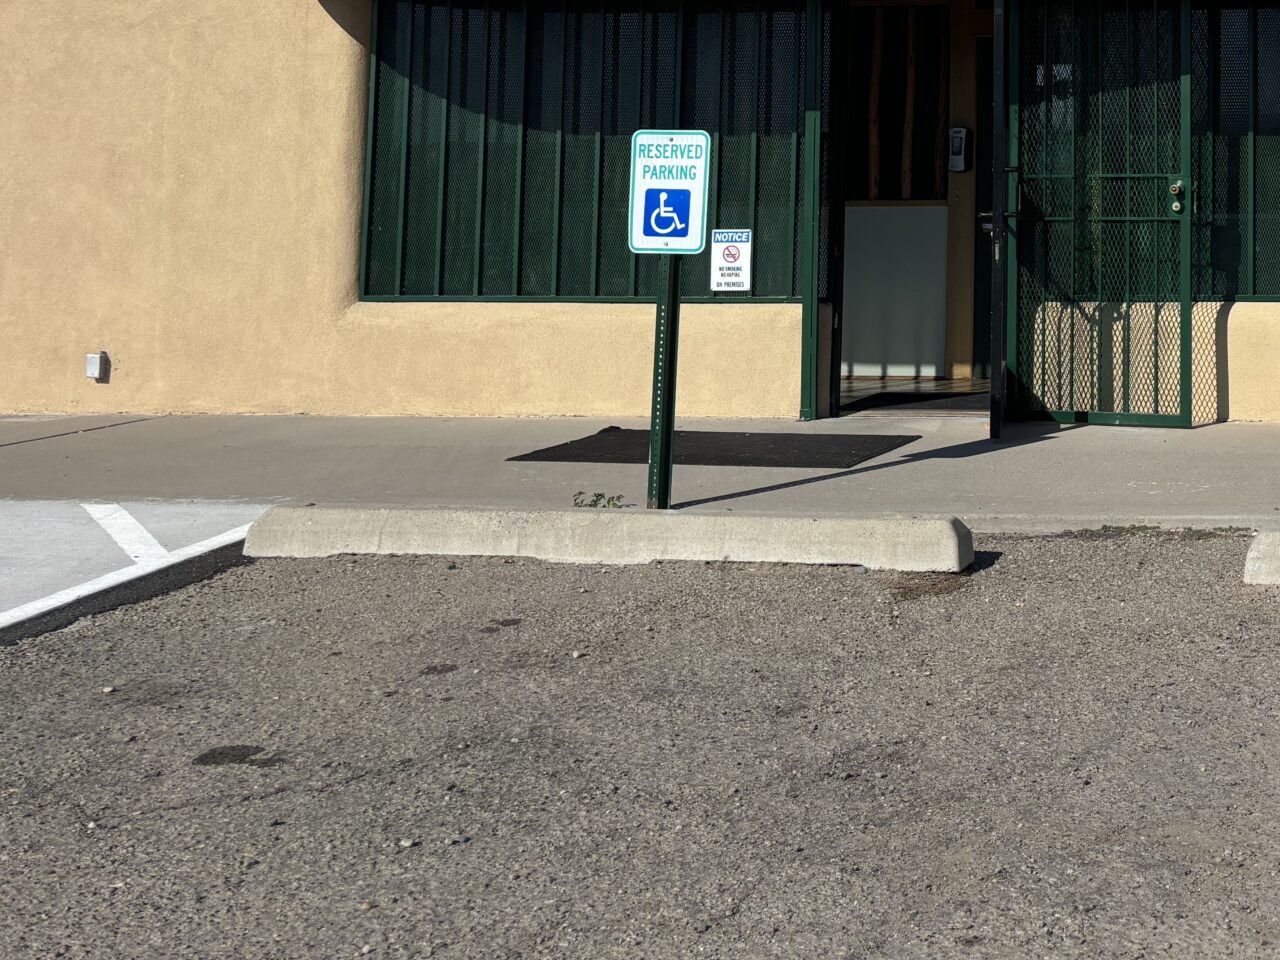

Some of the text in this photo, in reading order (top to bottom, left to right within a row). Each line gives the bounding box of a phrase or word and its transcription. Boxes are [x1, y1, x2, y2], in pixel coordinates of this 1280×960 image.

[638, 143, 703, 159] RESERVED
[642, 165, 697, 180] PARKING
[715, 232, 749, 241] NOTICE
